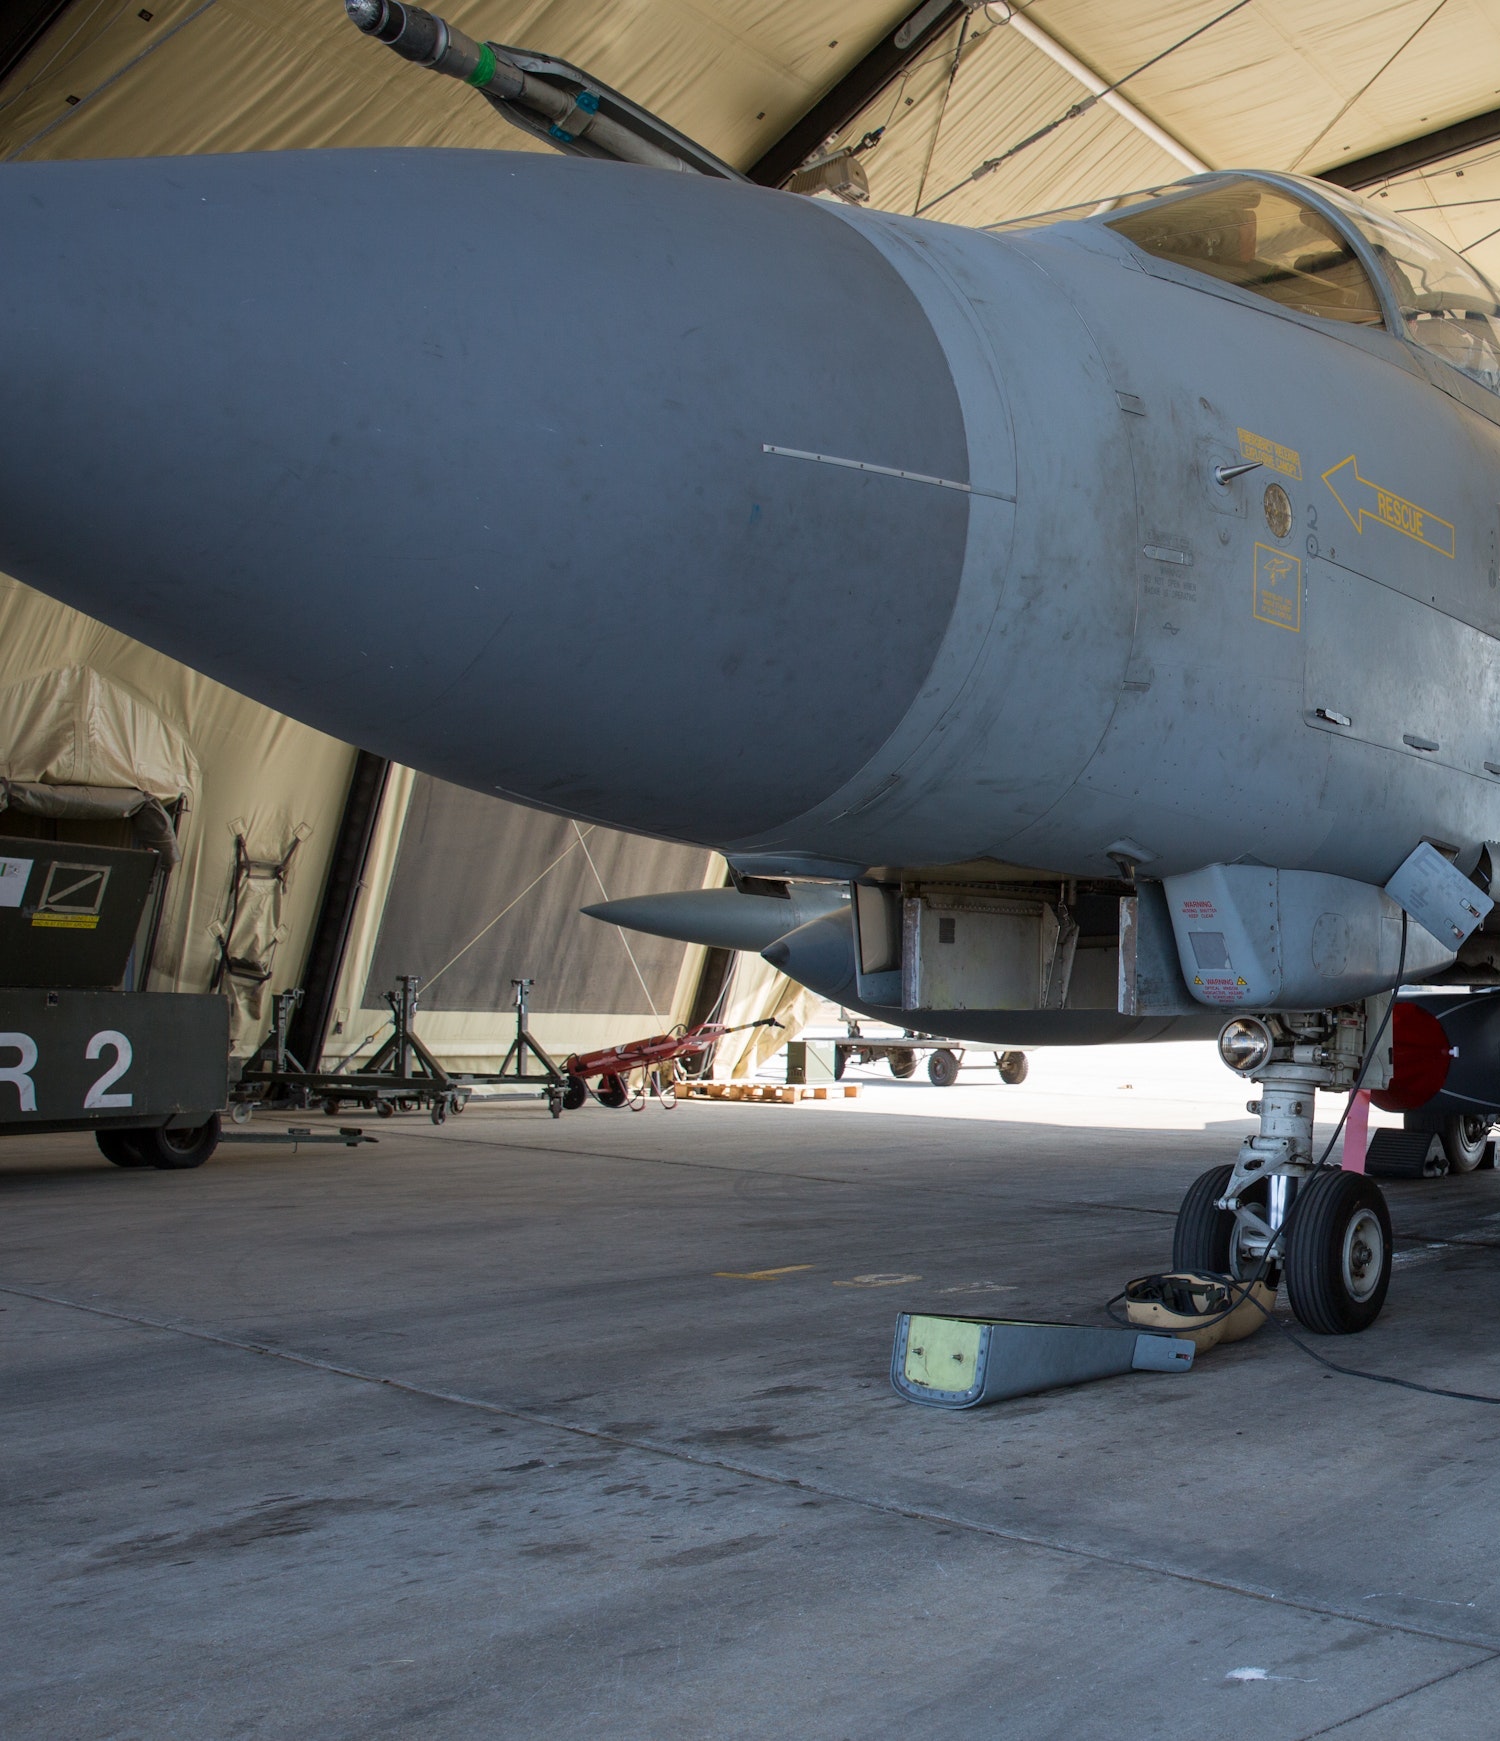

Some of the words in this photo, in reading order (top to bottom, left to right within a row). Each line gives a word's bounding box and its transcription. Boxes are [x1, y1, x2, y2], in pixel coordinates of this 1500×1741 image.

[1377, 492, 1424, 536] RESCUE
[1206, 978, 1234, 986] WARNING
[83, 1030, 133, 1109] 2
